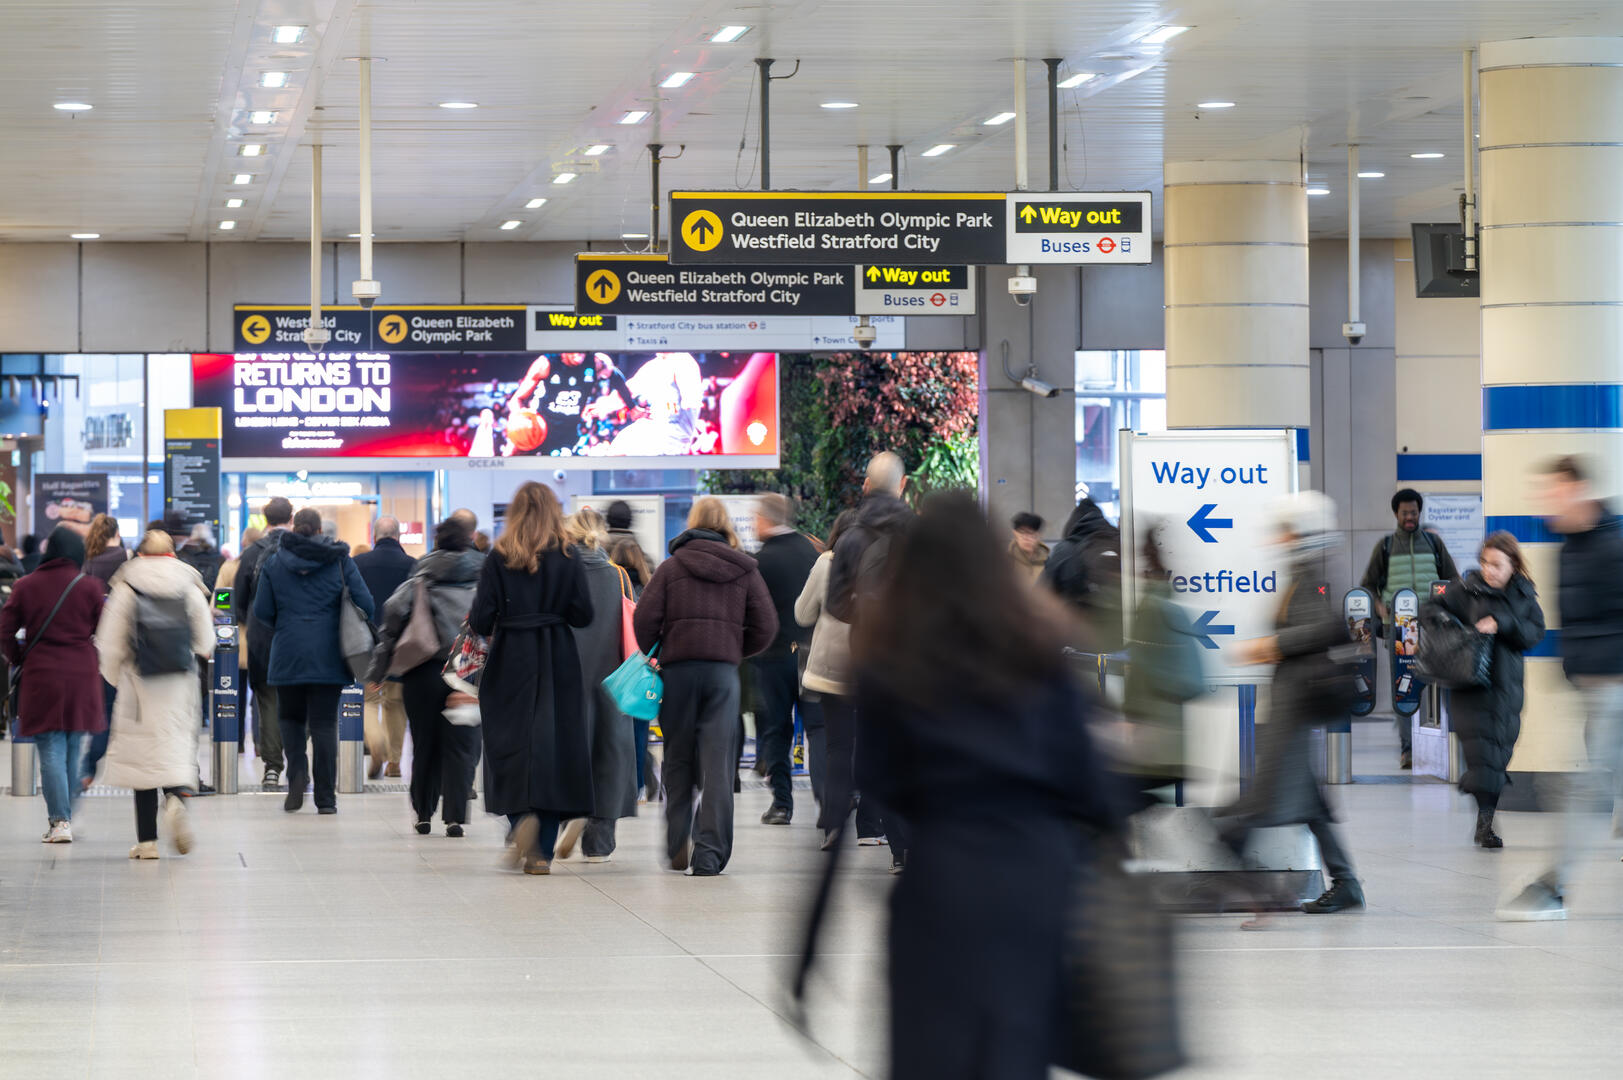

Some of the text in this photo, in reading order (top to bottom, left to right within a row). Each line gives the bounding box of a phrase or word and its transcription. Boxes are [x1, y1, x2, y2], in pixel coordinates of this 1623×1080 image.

[731, 212, 993, 231] Queen Elizabeth Olympic Park
[1039, 207, 1121, 228] Way out
[731, 233, 940, 252] Westfield Stratford City
[1041, 239, 1091, 253] Buses
[626, 271, 844, 288] Queen Elizabeth Olympic Park
[882, 267, 951, 286] Way out
[627, 289, 800, 305] Westfield Stratford City
[884, 294, 925, 306] Buses
[275, 316, 336, 329] Westeld
[411, 316, 514, 329] Queen Elizabeth
[549, 313, 603, 328] Way out
[636, 321, 746, 331] Stratford City bus station
[335, 329, 361, 344] City
[411, 329, 492, 344] Olympic Park
[636, 336, 657, 345] Taxis
[822, 336, 846, 344] Town
[234, 362, 391, 386] RETURNS TO
[234, 387, 391, 412] LONDON
[468, 459, 505, 468] OCEAN
[1151, 461, 1268, 490] Way out
[1162, 570, 1277, 593] estfield
